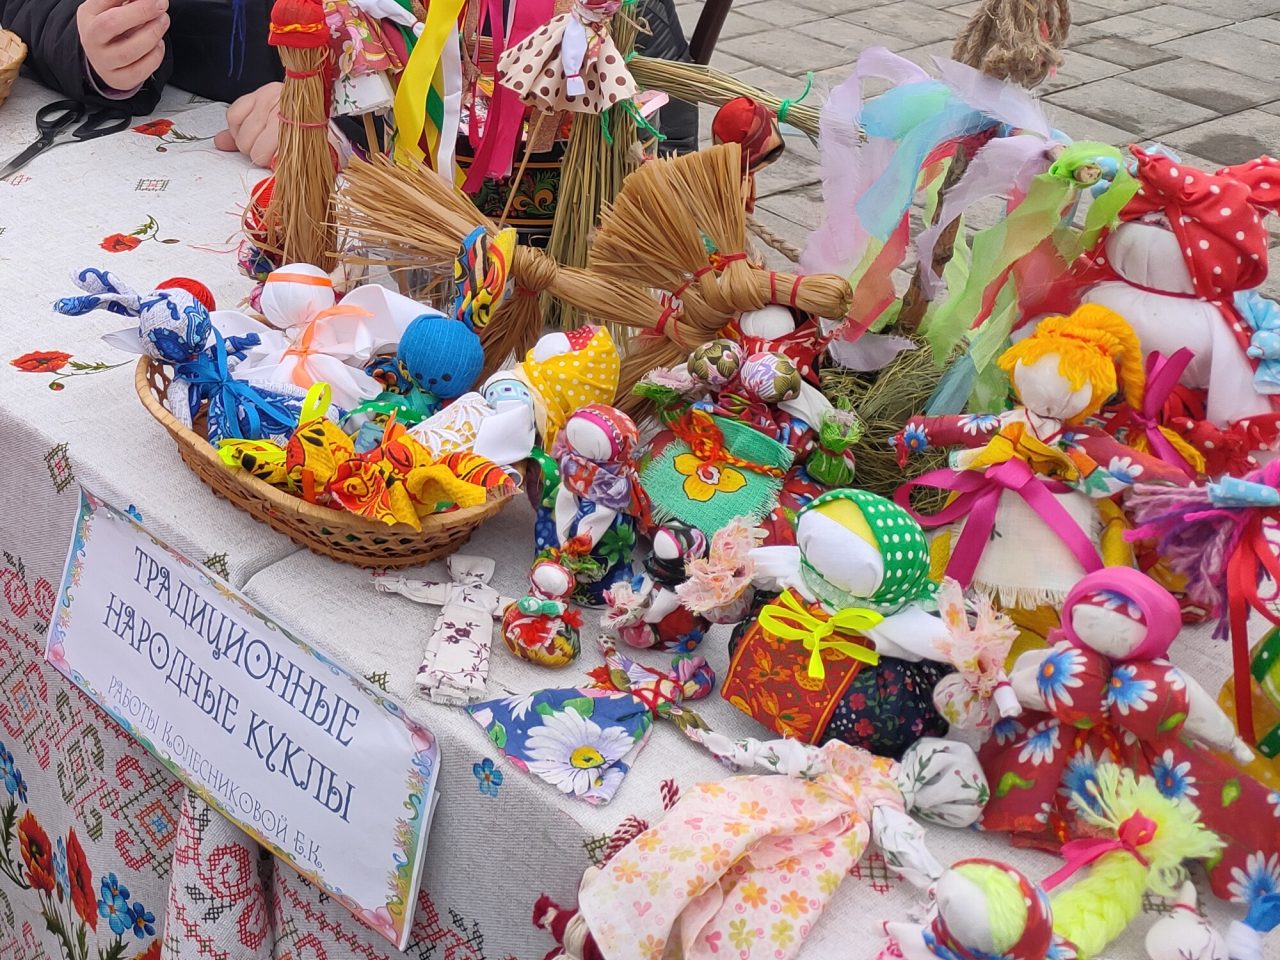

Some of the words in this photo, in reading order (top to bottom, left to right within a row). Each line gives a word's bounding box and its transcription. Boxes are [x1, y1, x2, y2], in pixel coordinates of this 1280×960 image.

[102, 592, 238, 734] НАРОДНЫЕ
[243, 709, 356, 823] КУКЛЫ
[134, 546, 360, 747] ТРАДИЦИОННЫЕ
[109, 676, 161, 737] РАБОТЫ
[161, 722, 289, 840] КОЛЕСНИКОВОЙ
